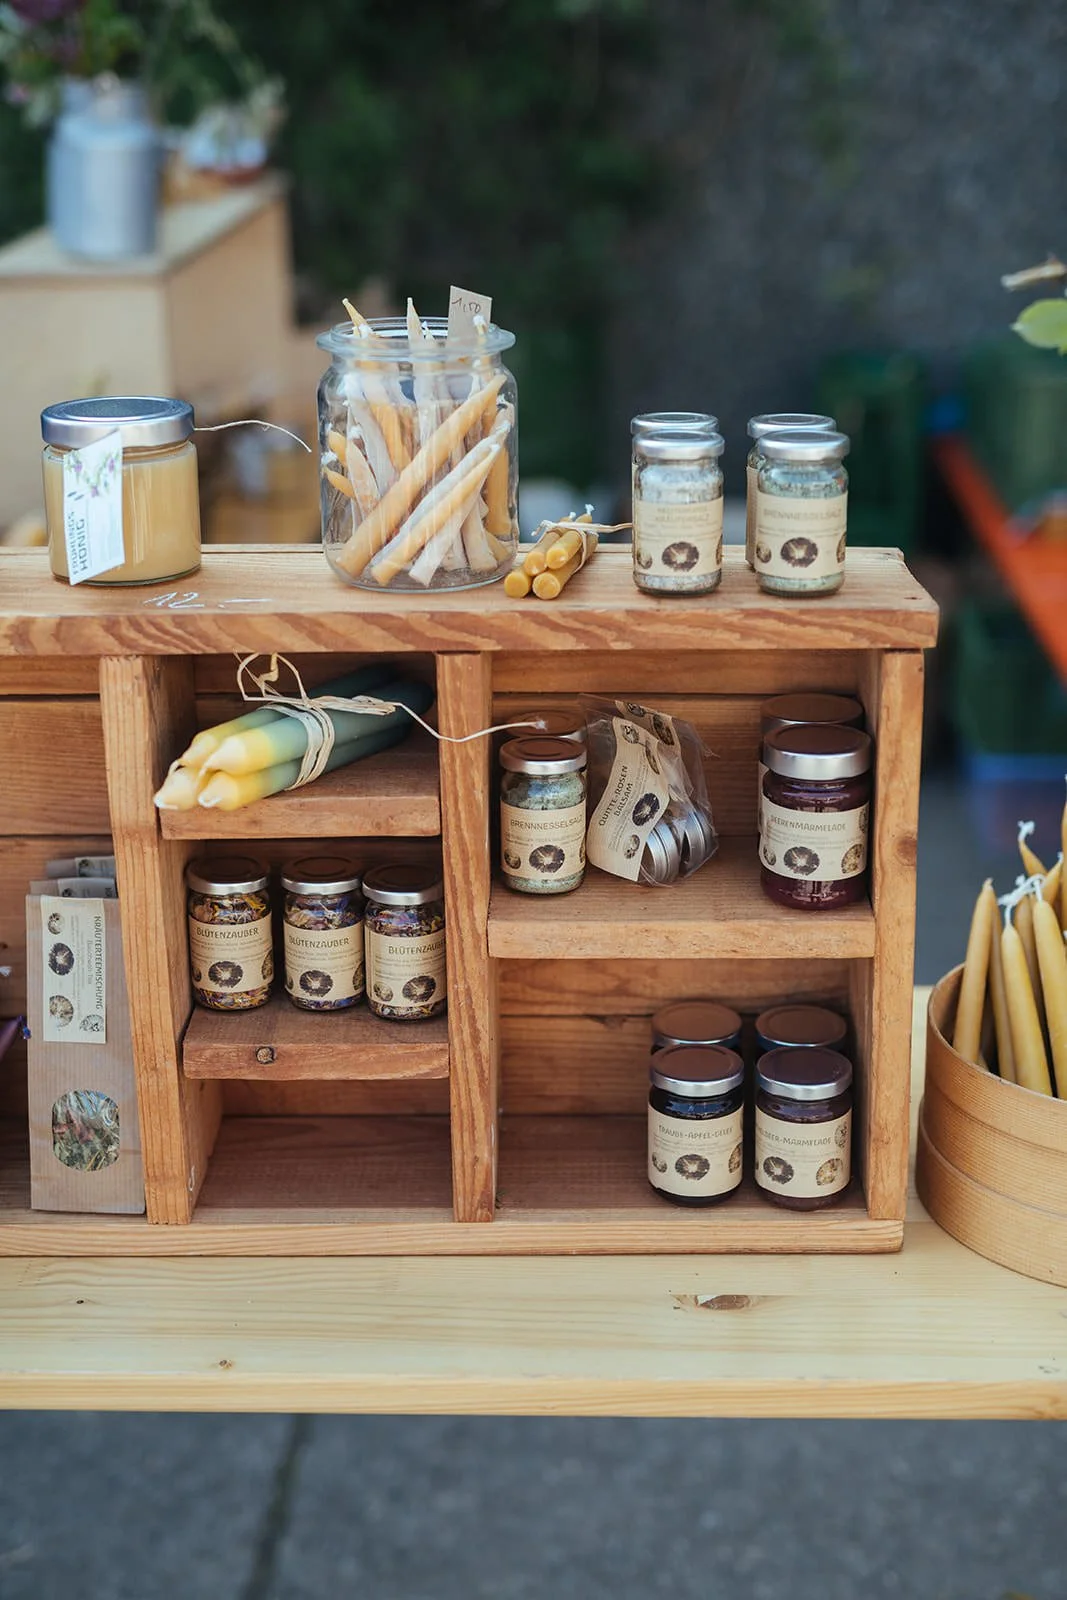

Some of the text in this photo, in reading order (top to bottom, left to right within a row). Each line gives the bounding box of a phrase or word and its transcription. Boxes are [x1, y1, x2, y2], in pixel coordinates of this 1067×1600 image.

[76, 519, 88, 571] HONIG
[598, 765, 628, 826] QUITTE-ROSEN
[613, 782, 633, 817] BALSAM
[196, 927, 260, 939] BLÜTENZAUBER
[289, 935, 350, 949] BLÜTENZAUBER
[94, 915, 104, 1010] KRÄUTERTEEMISCHUNG
